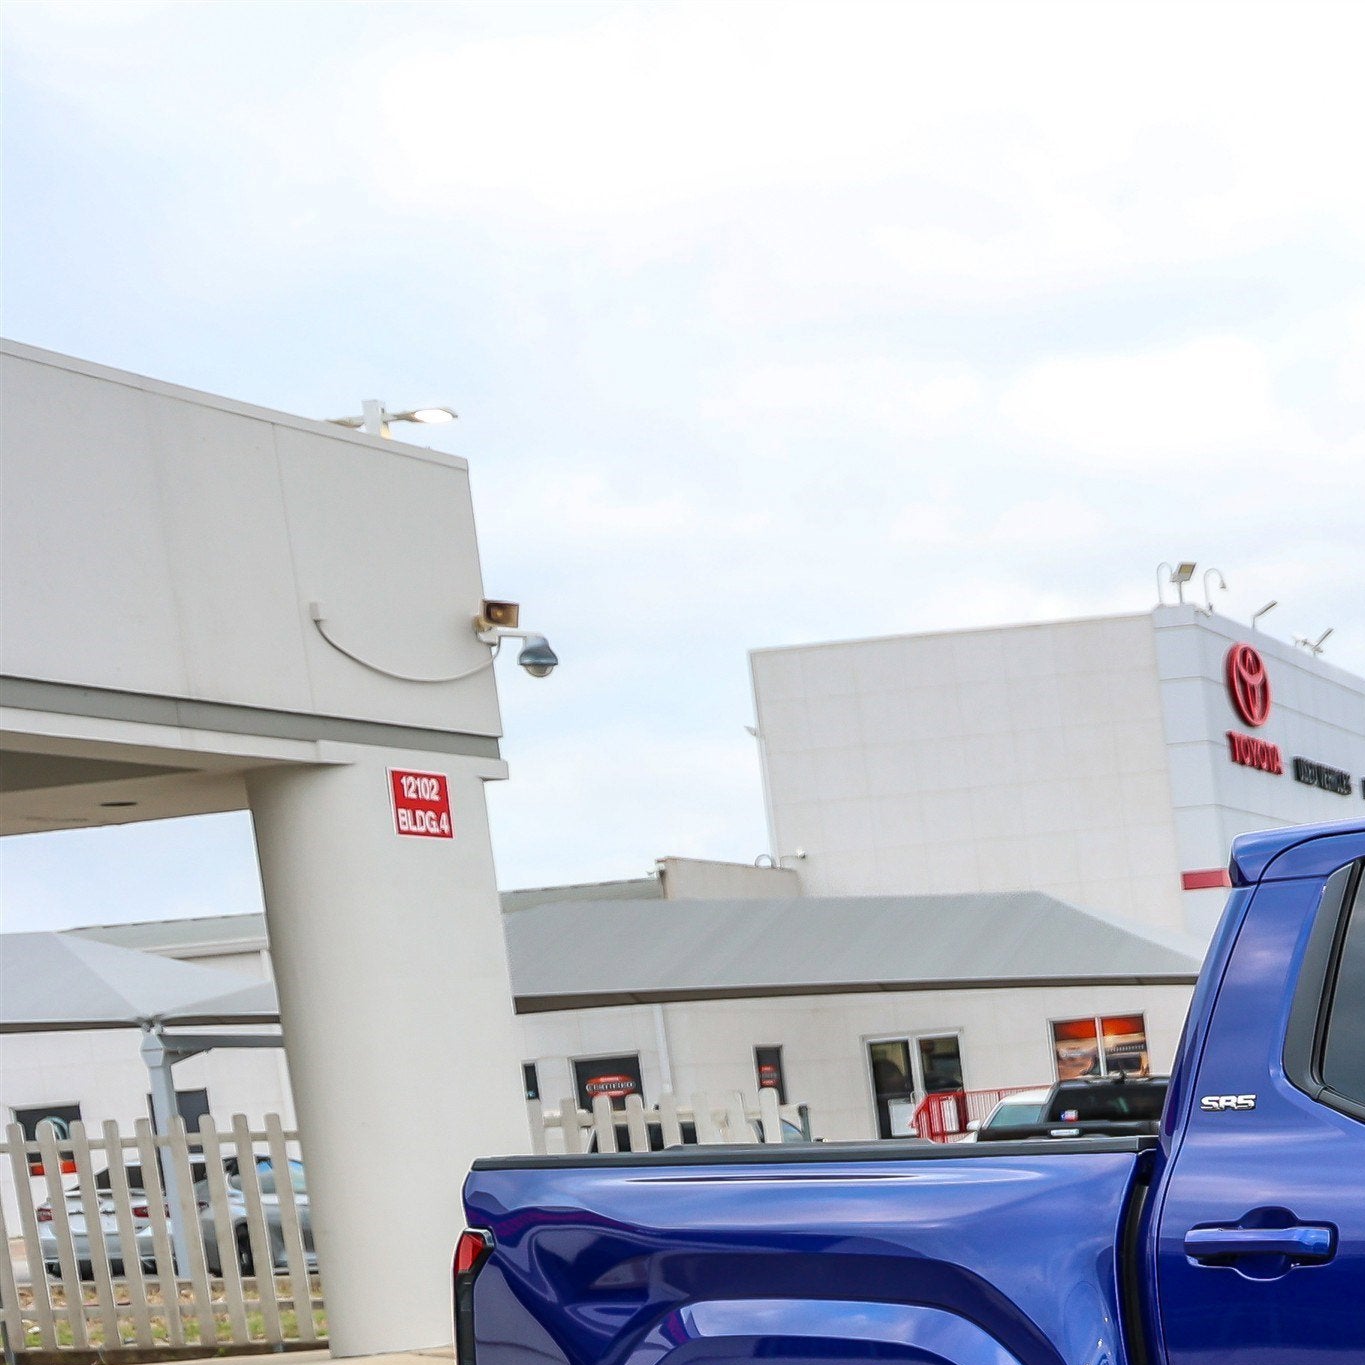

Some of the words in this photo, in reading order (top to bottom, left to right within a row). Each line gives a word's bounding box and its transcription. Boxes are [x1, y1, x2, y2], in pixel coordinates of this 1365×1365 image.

[1226, 730, 1283, 775] TOYOTA
[401, 775, 440, 801] 12102
[1200, 1094, 1256, 1111] SR5
